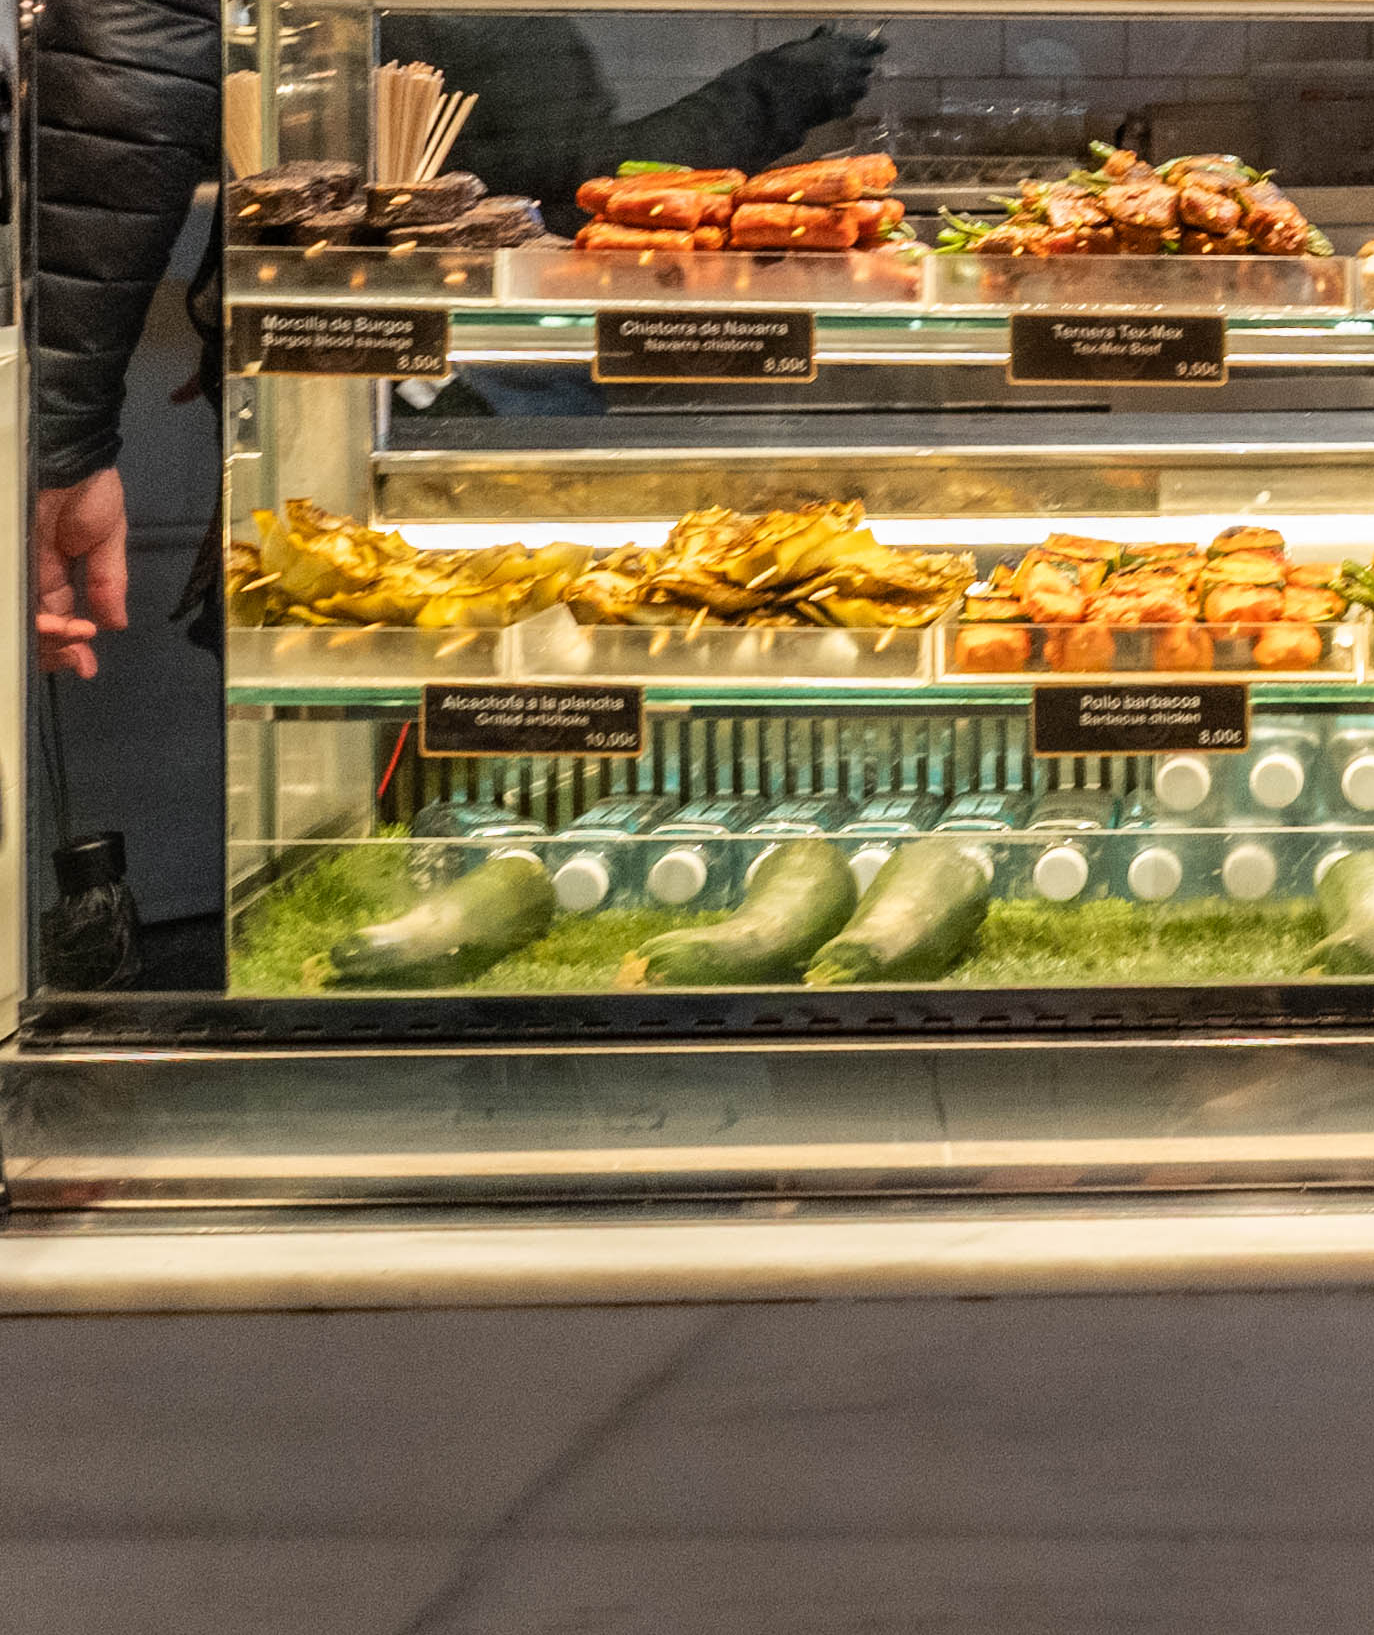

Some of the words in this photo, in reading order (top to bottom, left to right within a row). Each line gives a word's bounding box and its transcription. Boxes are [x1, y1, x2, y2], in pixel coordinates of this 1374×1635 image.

[262, 315, 328, 331] Morcilla
[329, 317, 352, 332] de
[354, 317, 414, 336] Burgos
[620, 320, 697, 336] Chistorra
[698, 320, 721, 336] de
[723, 321, 788, 336] Navarra
[1052, 324, 1116, 340] Ternera
[1118, 324, 1184, 340] Tex-Mex
[441, 695, 524, 710] Alcachofa
[525, 697, 538, 710] a
[540, 695, 556, 710] la
[557, 696, 624, 713] plancha
[1080, 695, 1121, 710] Pollo
[1123, 695, 1200, 710] barbacoa
